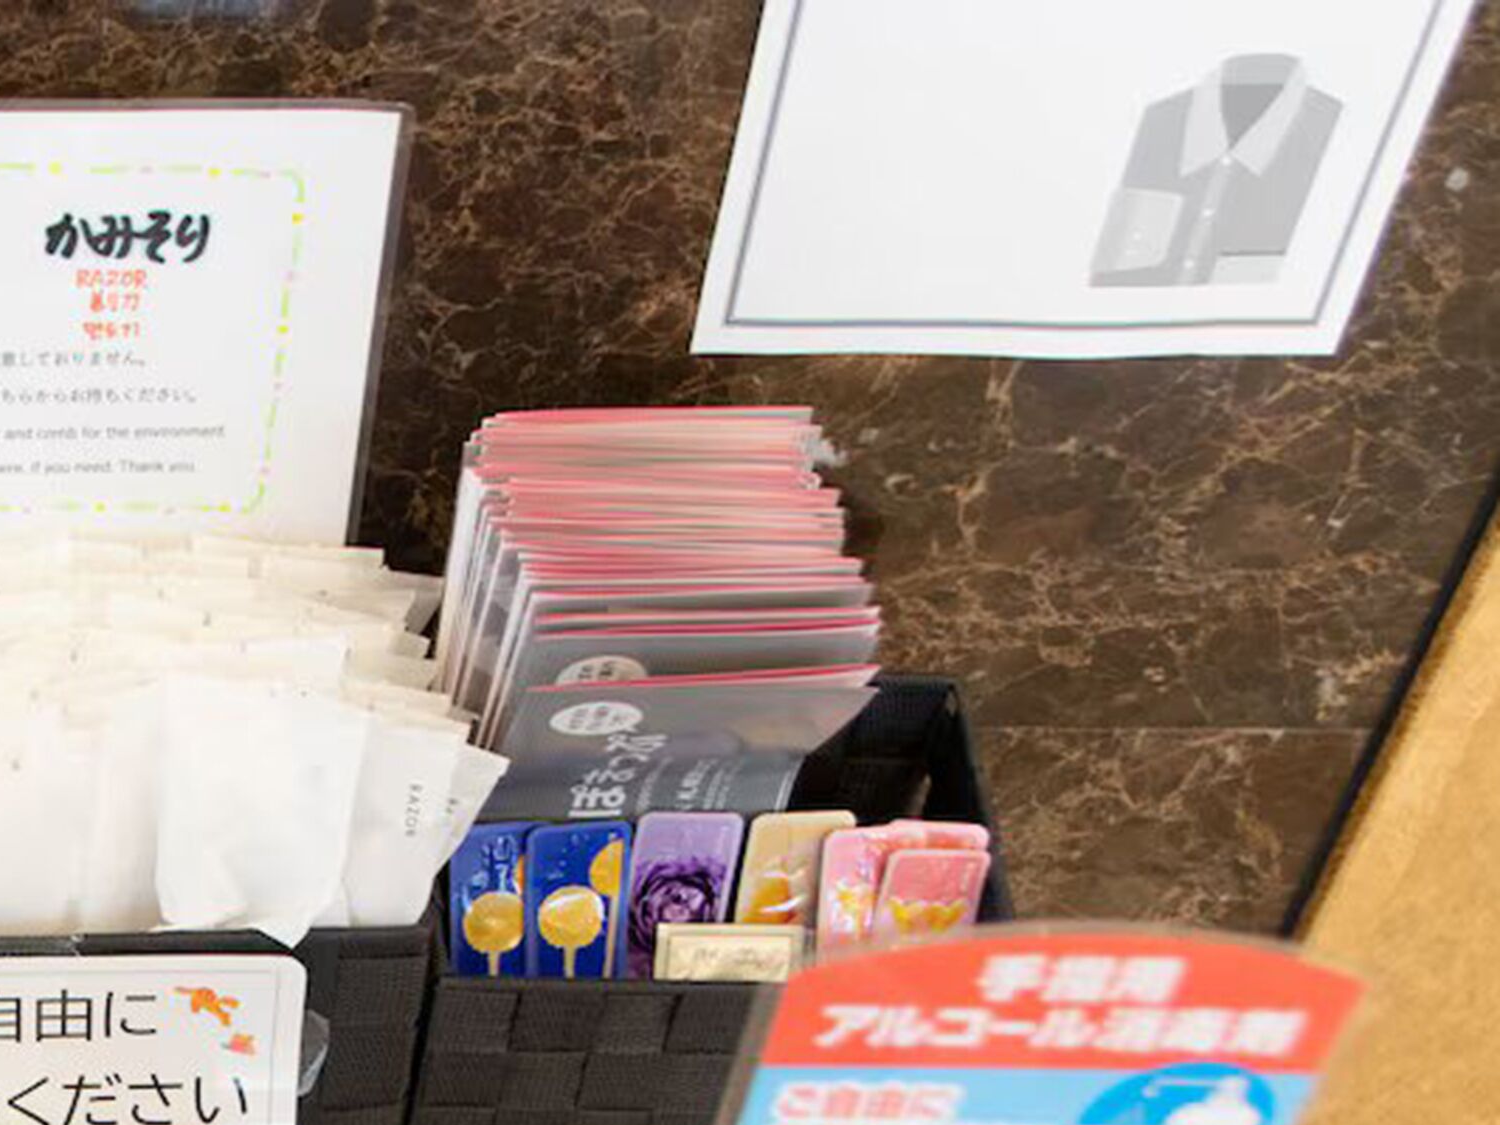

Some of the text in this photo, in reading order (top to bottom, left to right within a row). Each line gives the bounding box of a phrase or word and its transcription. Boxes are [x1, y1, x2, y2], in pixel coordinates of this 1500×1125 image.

[44, 211, 212, 264] かみそり
[76, 269, 148, 289] RAZOR
[4, 427, 33, 440] and
[36, 427, 79, 440] comb
[82, 427, 103, 439] for
[106, 426, 130, 439] the
[43, 463, 70, 478] you
[119, 460, 164, 473] Thank
